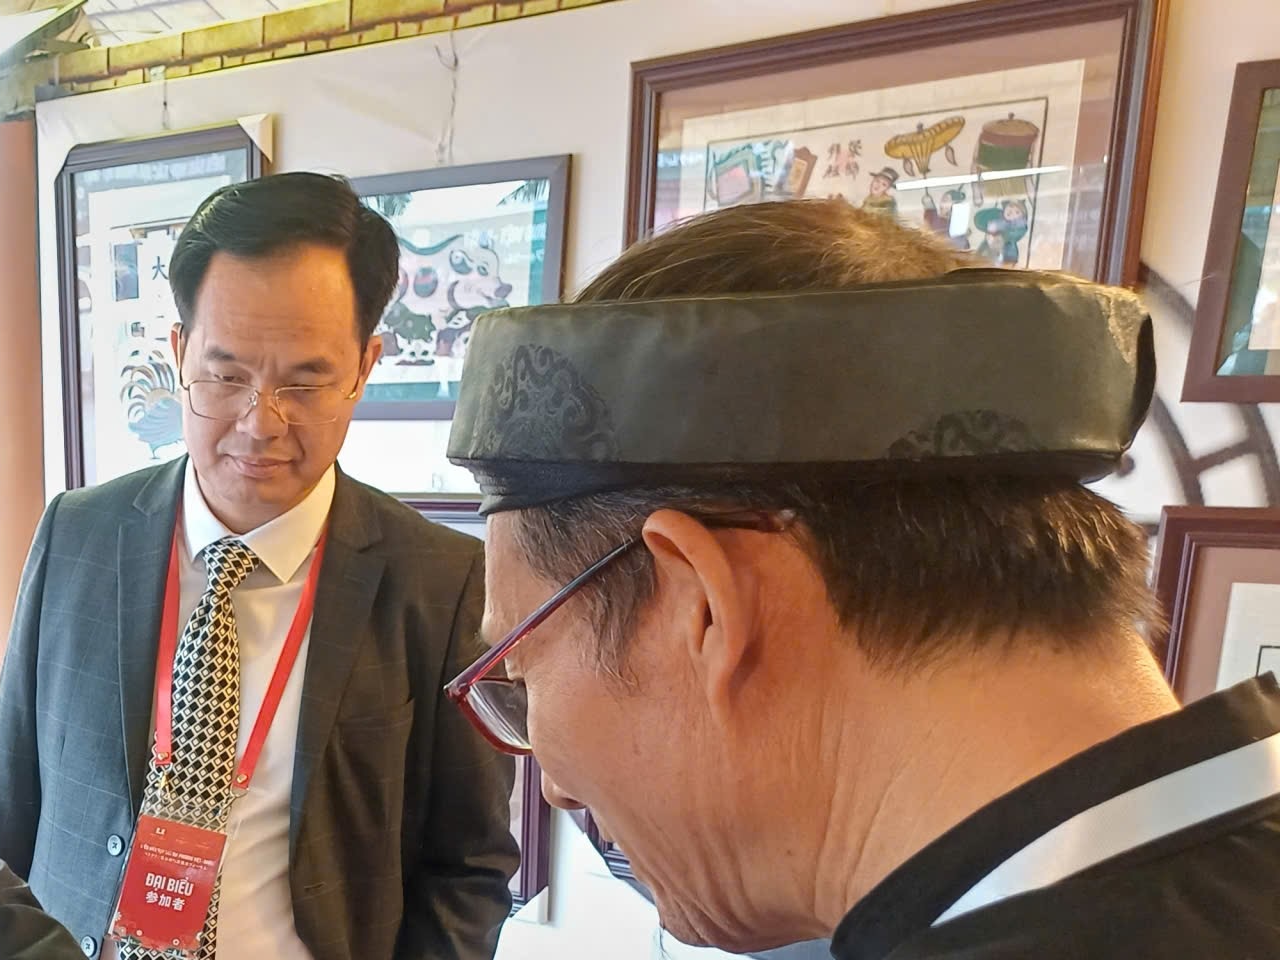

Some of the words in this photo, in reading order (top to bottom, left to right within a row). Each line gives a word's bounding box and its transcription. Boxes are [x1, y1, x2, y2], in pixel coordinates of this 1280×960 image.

[145, 872, 166, 891] ĐẠI
[166, 877, 194, 897] BIỂU
[145, 890, 186, 911] 参加者
